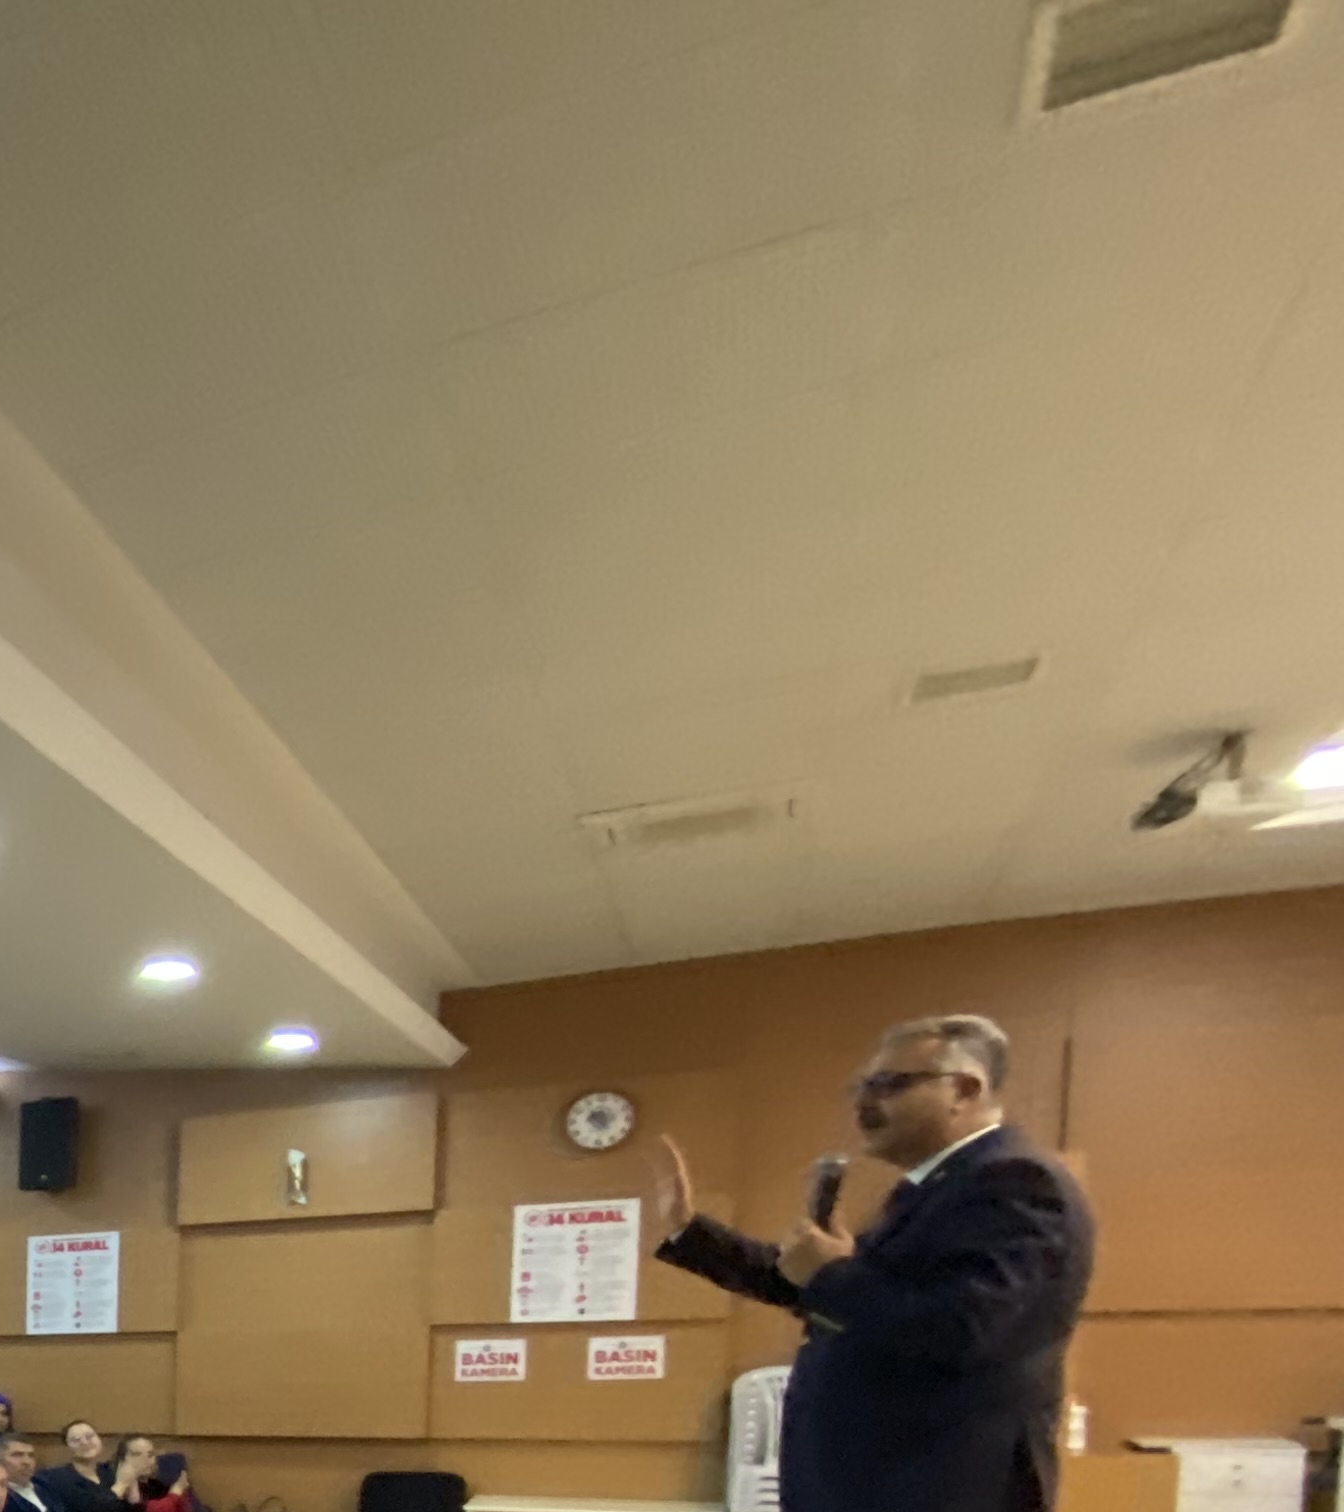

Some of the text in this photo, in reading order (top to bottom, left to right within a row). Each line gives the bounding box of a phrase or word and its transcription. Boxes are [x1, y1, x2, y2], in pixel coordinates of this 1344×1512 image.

[568, 1210, 627, 1225] KURAL
[67, 1240, 109, 1252] KURAL
[462, 1352, 519, 1366] BASIN
[595, 1349, 657, 1364] BASIN
[461, 1367, 519, 1377] KAMERA
[594, 1365, 656, 1375] KAMERA
